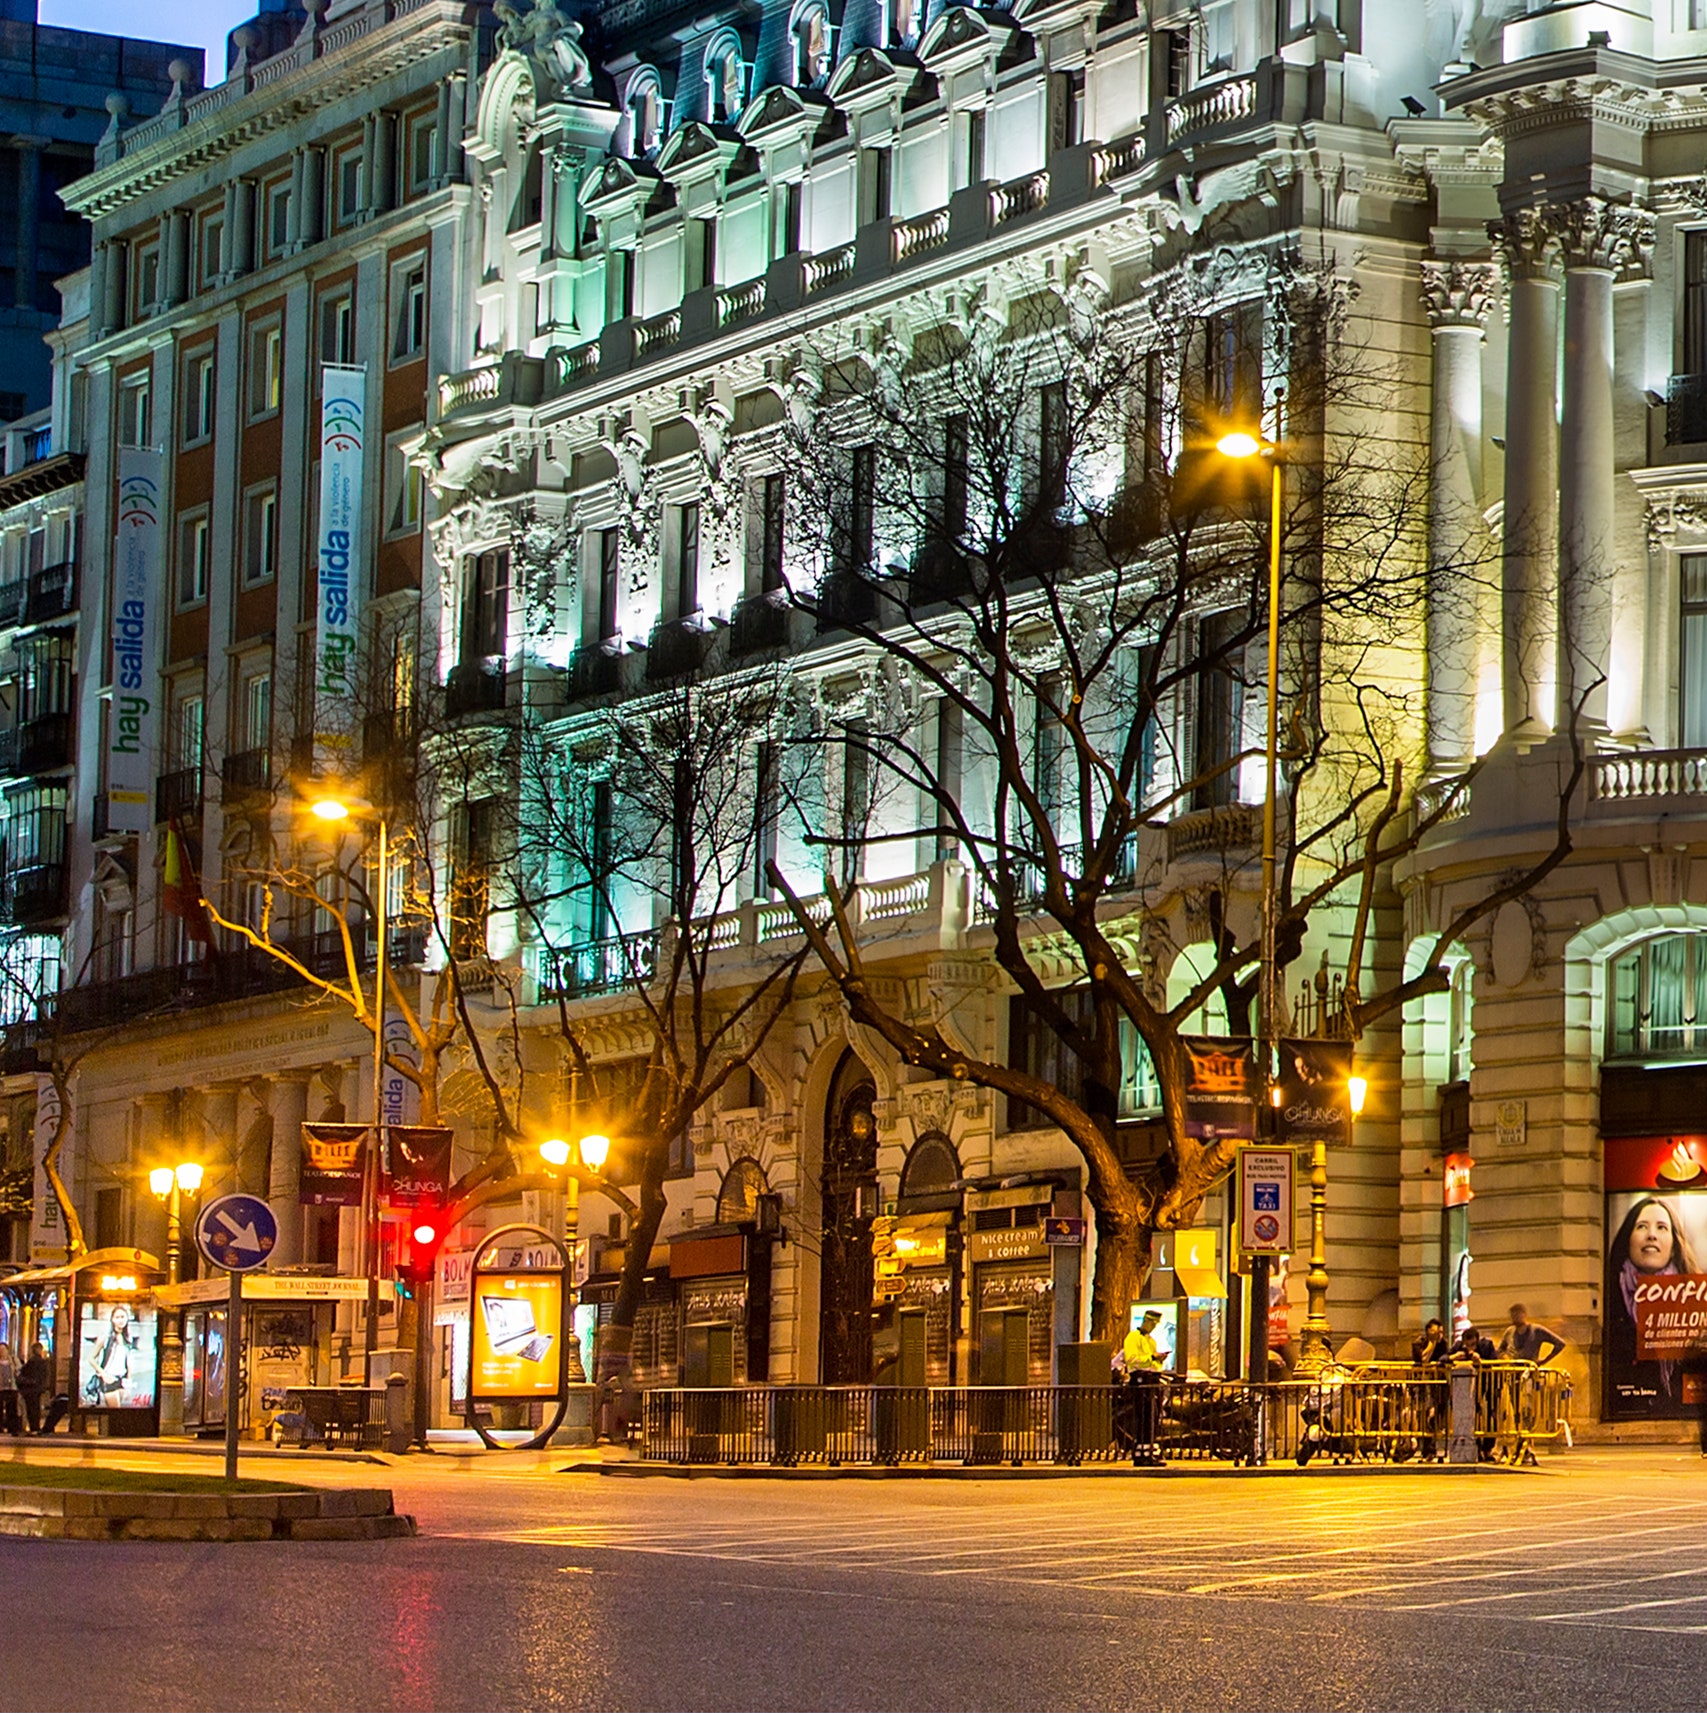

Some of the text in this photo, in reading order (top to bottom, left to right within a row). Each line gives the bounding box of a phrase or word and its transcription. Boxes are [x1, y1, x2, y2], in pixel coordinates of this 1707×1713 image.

[315, 529, 355, 695] hay salida
[114, 600, 146, 690] salida
[112, 696, 149, 754] hay
[274, 1281, 360, 1291] THE WALL STREET JOURNAL
[1645, 1313, 1653, 1328] 4
[1644, 1330, 1654, 1339] de
[1656, 1328, 1686, 1338] clientes
[1688, 1329, 1698, 1337] no
[1644, 1338, 1684, 1349] comisiones
